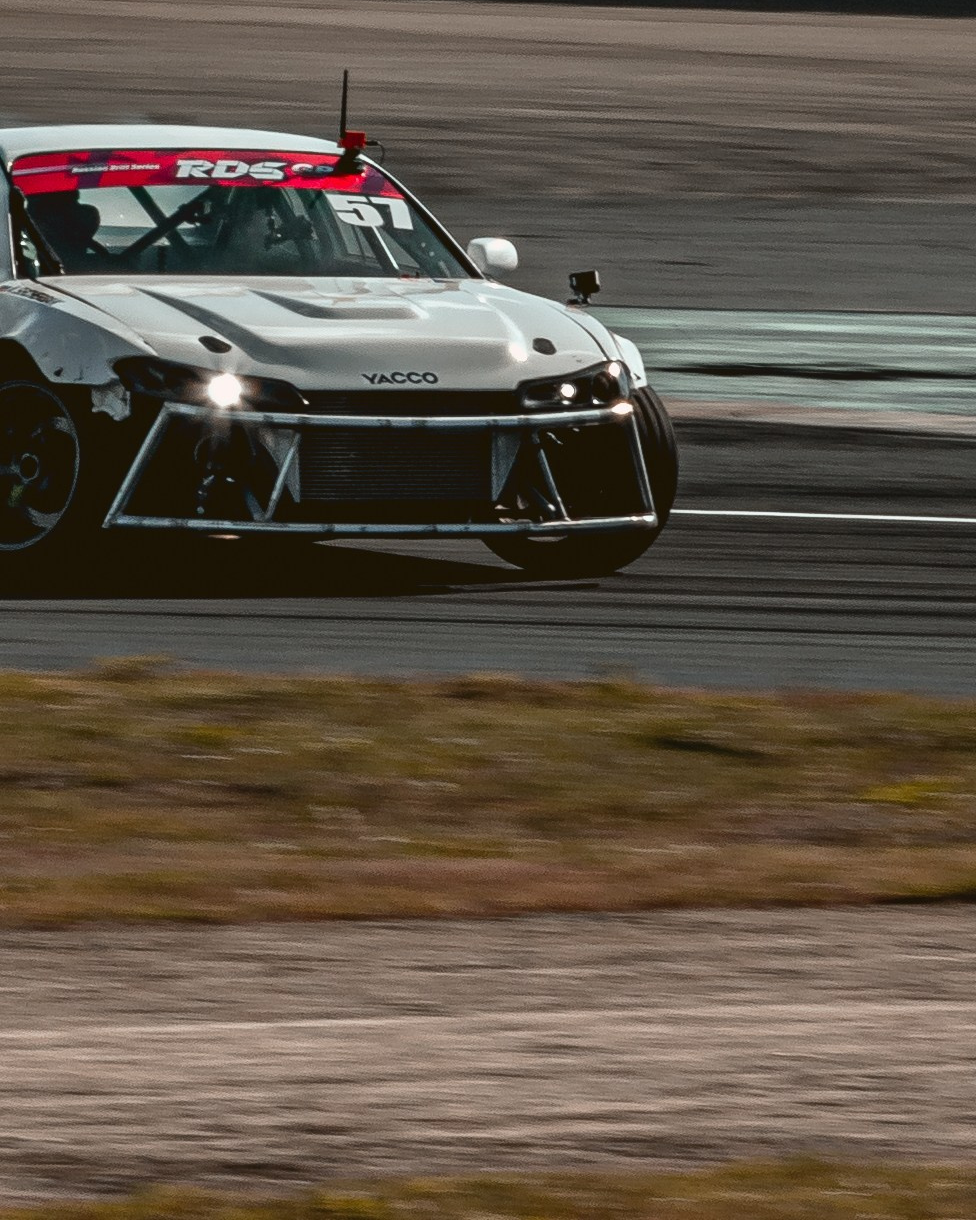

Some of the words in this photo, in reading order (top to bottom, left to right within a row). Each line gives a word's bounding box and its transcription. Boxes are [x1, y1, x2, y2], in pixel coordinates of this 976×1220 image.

[176, 158, 287, 180] RDS
[325, 192, 414, 231] 57
[361, 371, 439, 385] YACCO
